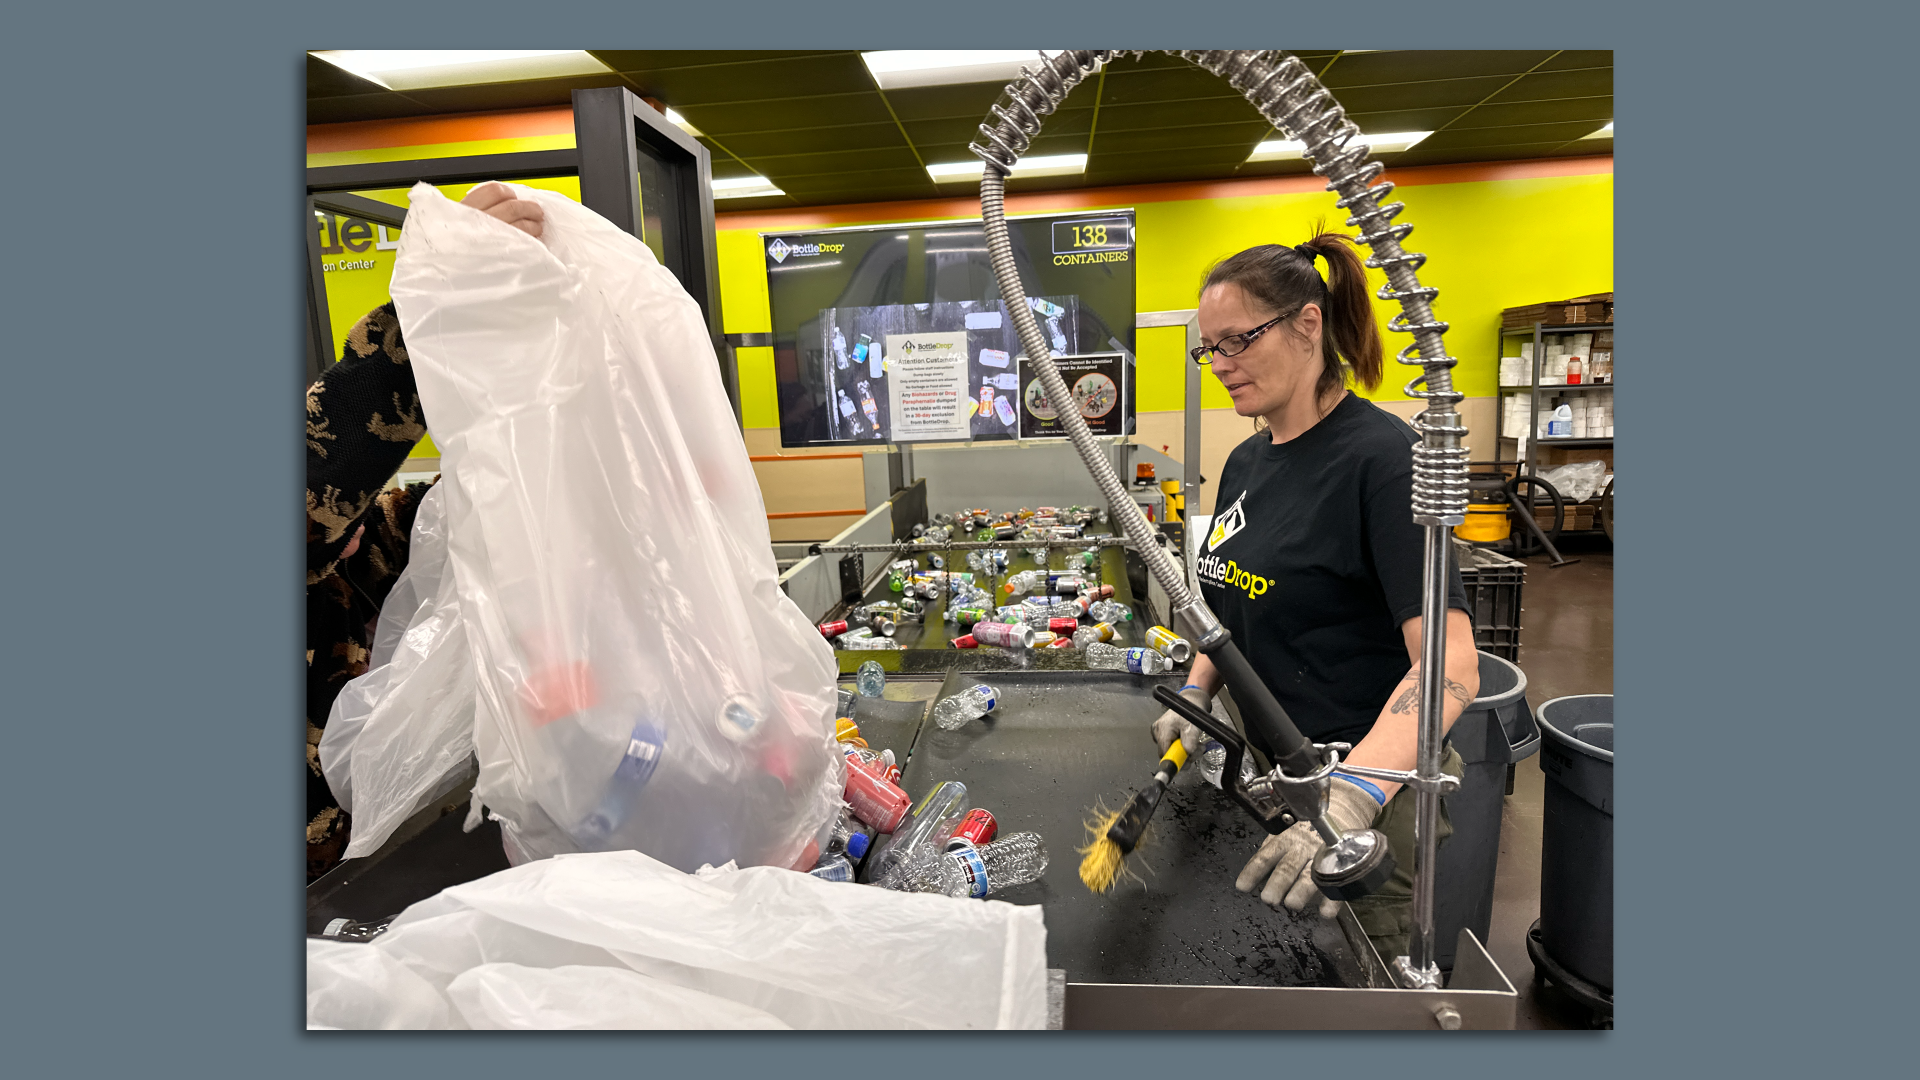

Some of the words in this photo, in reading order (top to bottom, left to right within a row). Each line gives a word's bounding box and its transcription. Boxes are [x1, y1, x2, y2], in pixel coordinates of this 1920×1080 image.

[1072, 224, 1108, 247] 138
[792, 243, 844, 254] BottleDrop
[339, 260, 374, 270] Center
[1053, 251, 1128, 266] CONTAINERS
